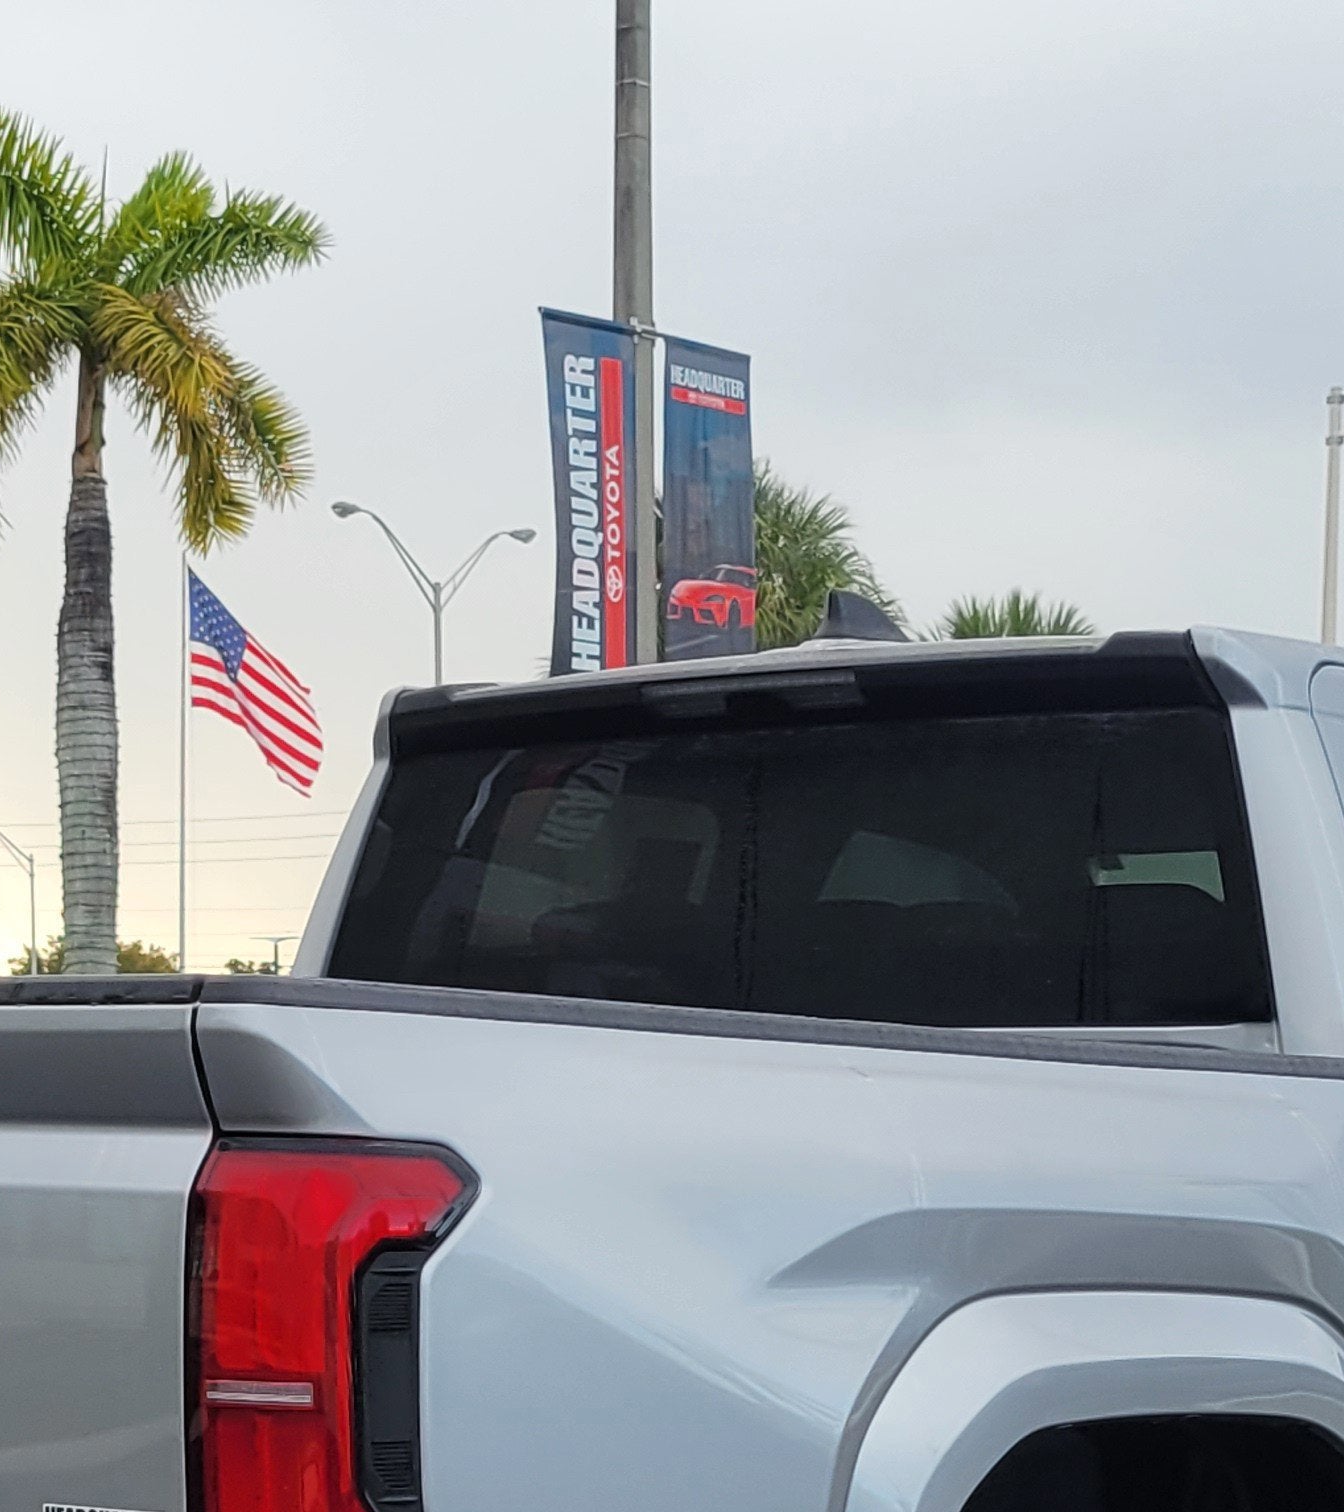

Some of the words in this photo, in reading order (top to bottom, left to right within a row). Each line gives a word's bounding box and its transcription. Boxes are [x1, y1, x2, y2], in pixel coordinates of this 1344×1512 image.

[670, 363, 746, 400] HEADQUARTER
[563, 354, 603, 673] HEADQUARTER
[605, 444, 621, 562] TOYOTA
